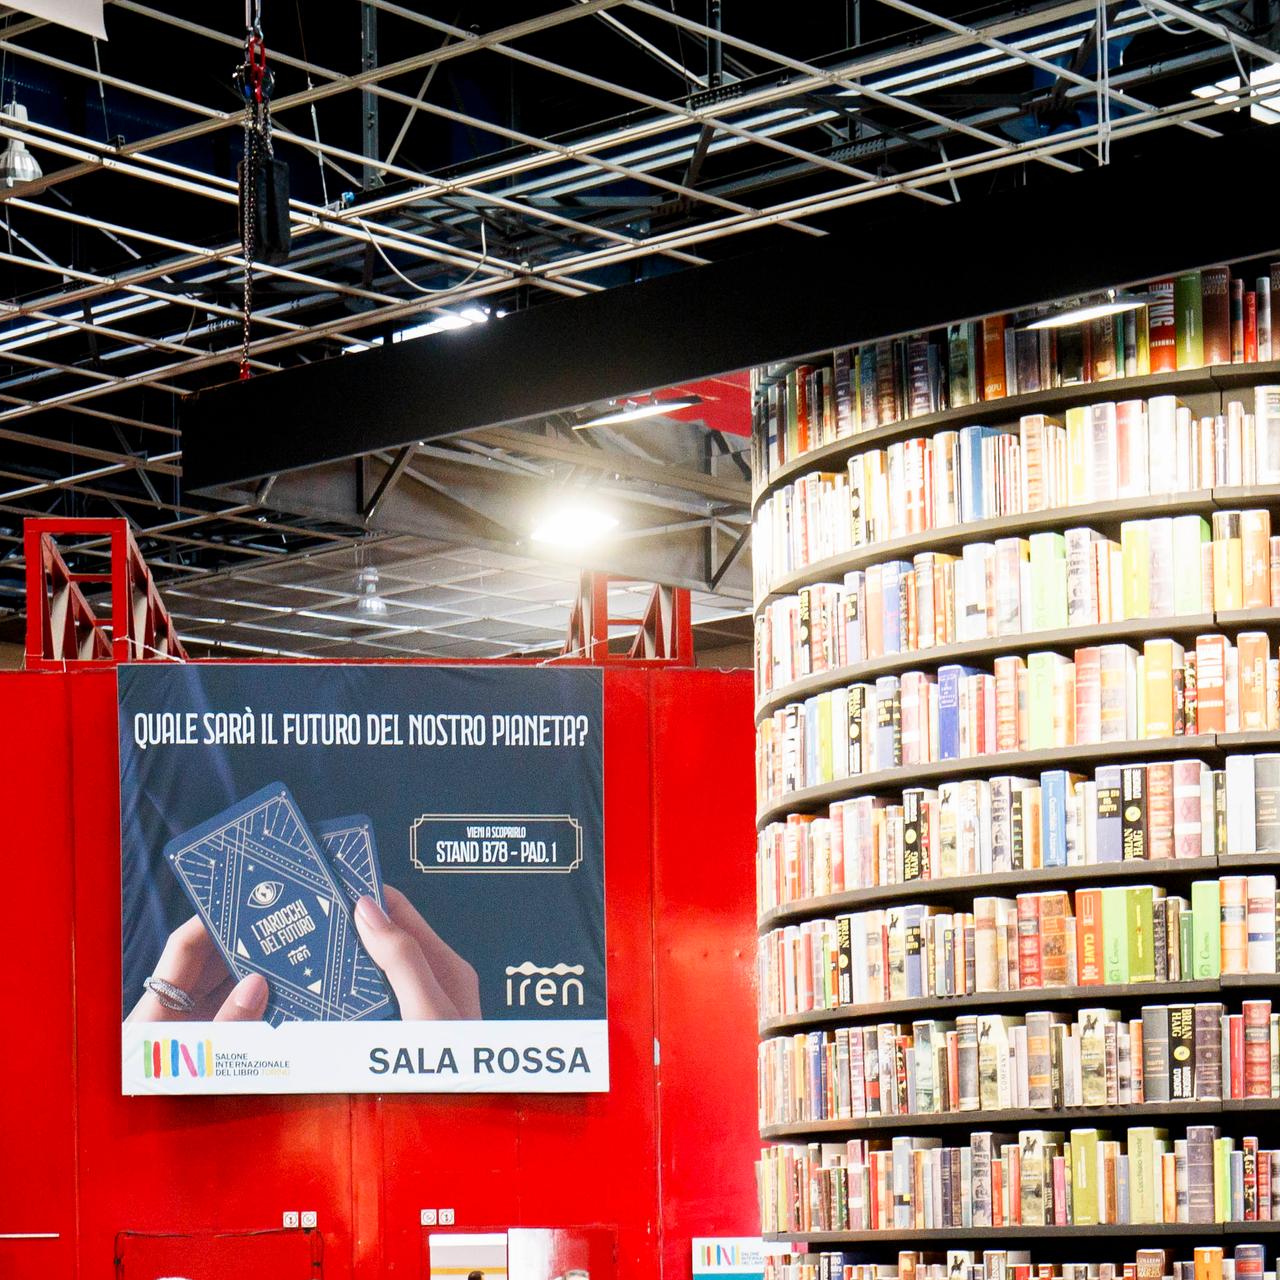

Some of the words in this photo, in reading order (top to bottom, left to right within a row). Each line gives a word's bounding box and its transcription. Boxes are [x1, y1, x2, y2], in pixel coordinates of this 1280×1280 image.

[134, 712, 199, 749] QUALE
[203, 706, 255, 745] SARÀ
[261, 713, 278, 745] IL
[283, 713, 361, 745] FUTURO
[366, 713, 403, 746] DEL
[408, 713, 486, 746] NOSTRO
[492, 714, 589, 747] PIANETA?
[467, 826, 485, 838] VIENI
[486, 826, 491, 838] A
[491, 826, 527, 838] SCOPRIRLO
[1124, 828, 1133, 860] BRIAN
[1133, 829, 1144, 858] HAIG
[436, 840, 479, 863] STAND
[482, 841, 508, 863] B78
[521, 841, 550, 863] PAD.
[551, 841, 557, 863] 1
[255, 899, 308, 937] TAROCCHI
[251, 925, 261, 941] I
[260, 934, 282, 956] DEL
[277, 915, 316, 946] FUTURO
[287, 946, 311, 966] iren
[1084, 933, 1095, 963] CLAVE
[506, 970, 584, 1006] iren
[1172, 1011, 1182, 1038] HAIG
[1181, 1008, 1193, 1040] BRIAN
[215, 1053, 248, 1061] SALONE
[215, 1060, 290, 1069] INTERNAZIONALE
[368, 1047, 460, 1075] SALA
[473, 1046, 591, 1075] ROSSA
[215, 1069, 232, 1077] DEL
[233, 1069, 259, 1077] LIBRO
